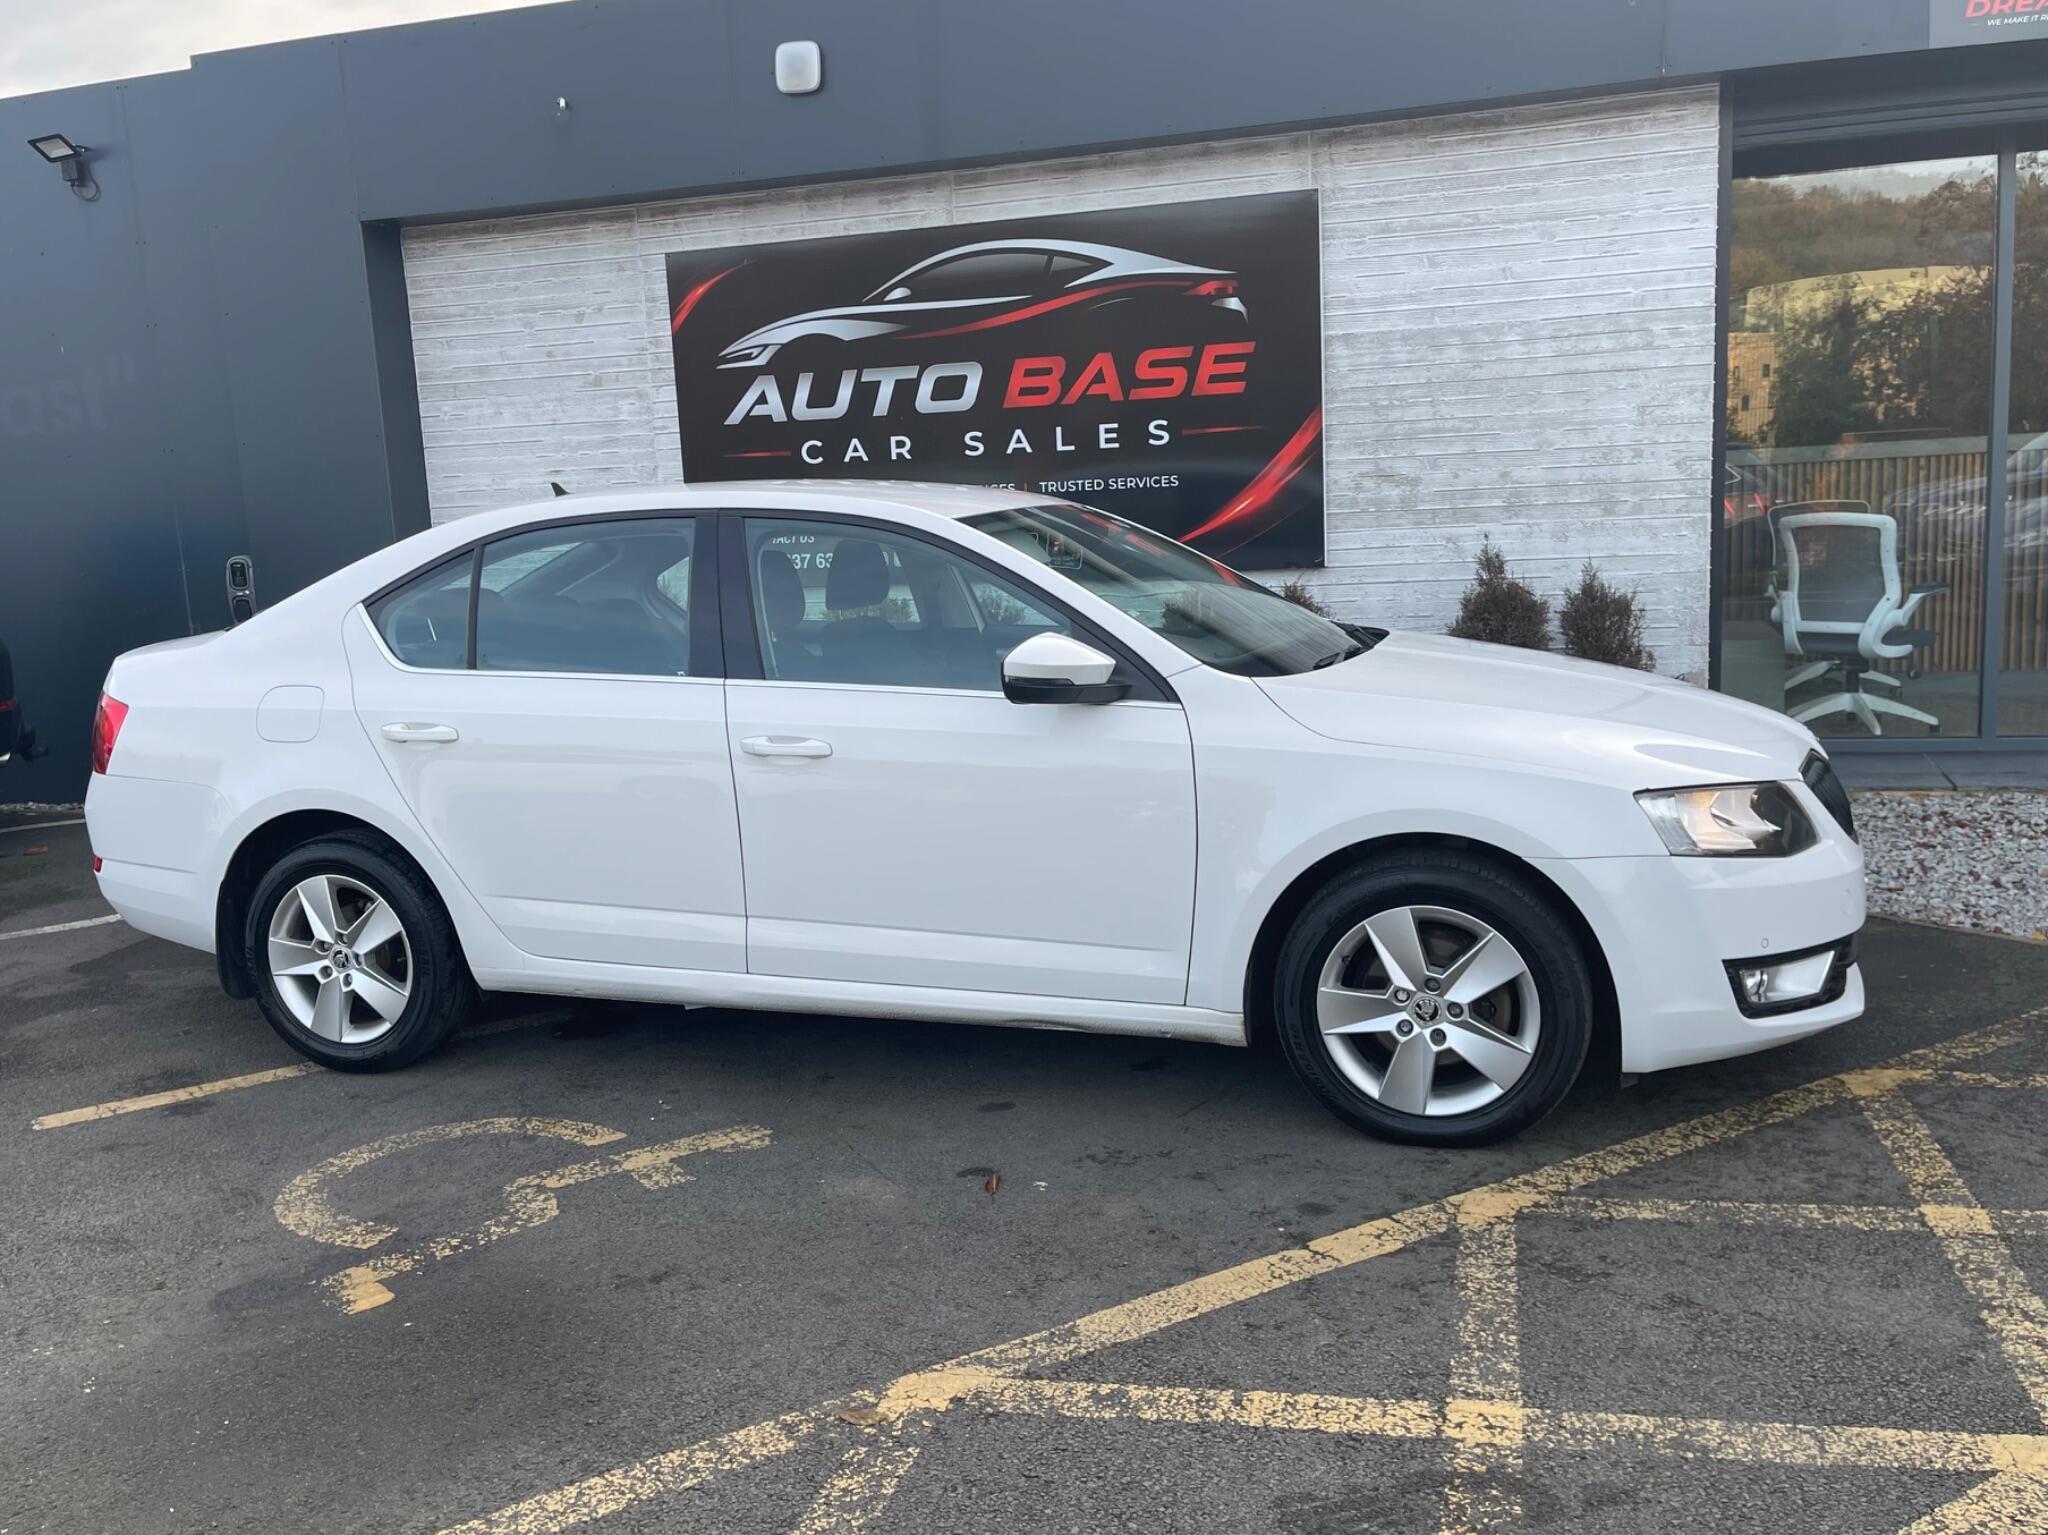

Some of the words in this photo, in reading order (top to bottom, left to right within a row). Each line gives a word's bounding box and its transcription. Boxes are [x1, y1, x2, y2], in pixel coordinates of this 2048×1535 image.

[1987, 18, 2001, 26] WE
[2003, 15, 2030, 25] MAKE
[2030, 14, 2040, 22] IT
[723, 361, 984, 425] AUTO
[1002, 341, 1256, 409] BASE
[800, 436, 912, 464] CAR
[963, 419, 1171, 457] SALES
[1039, 478, 1104, 493] TRUSTED
[1108, 475, 1179, 490] SERVICES
